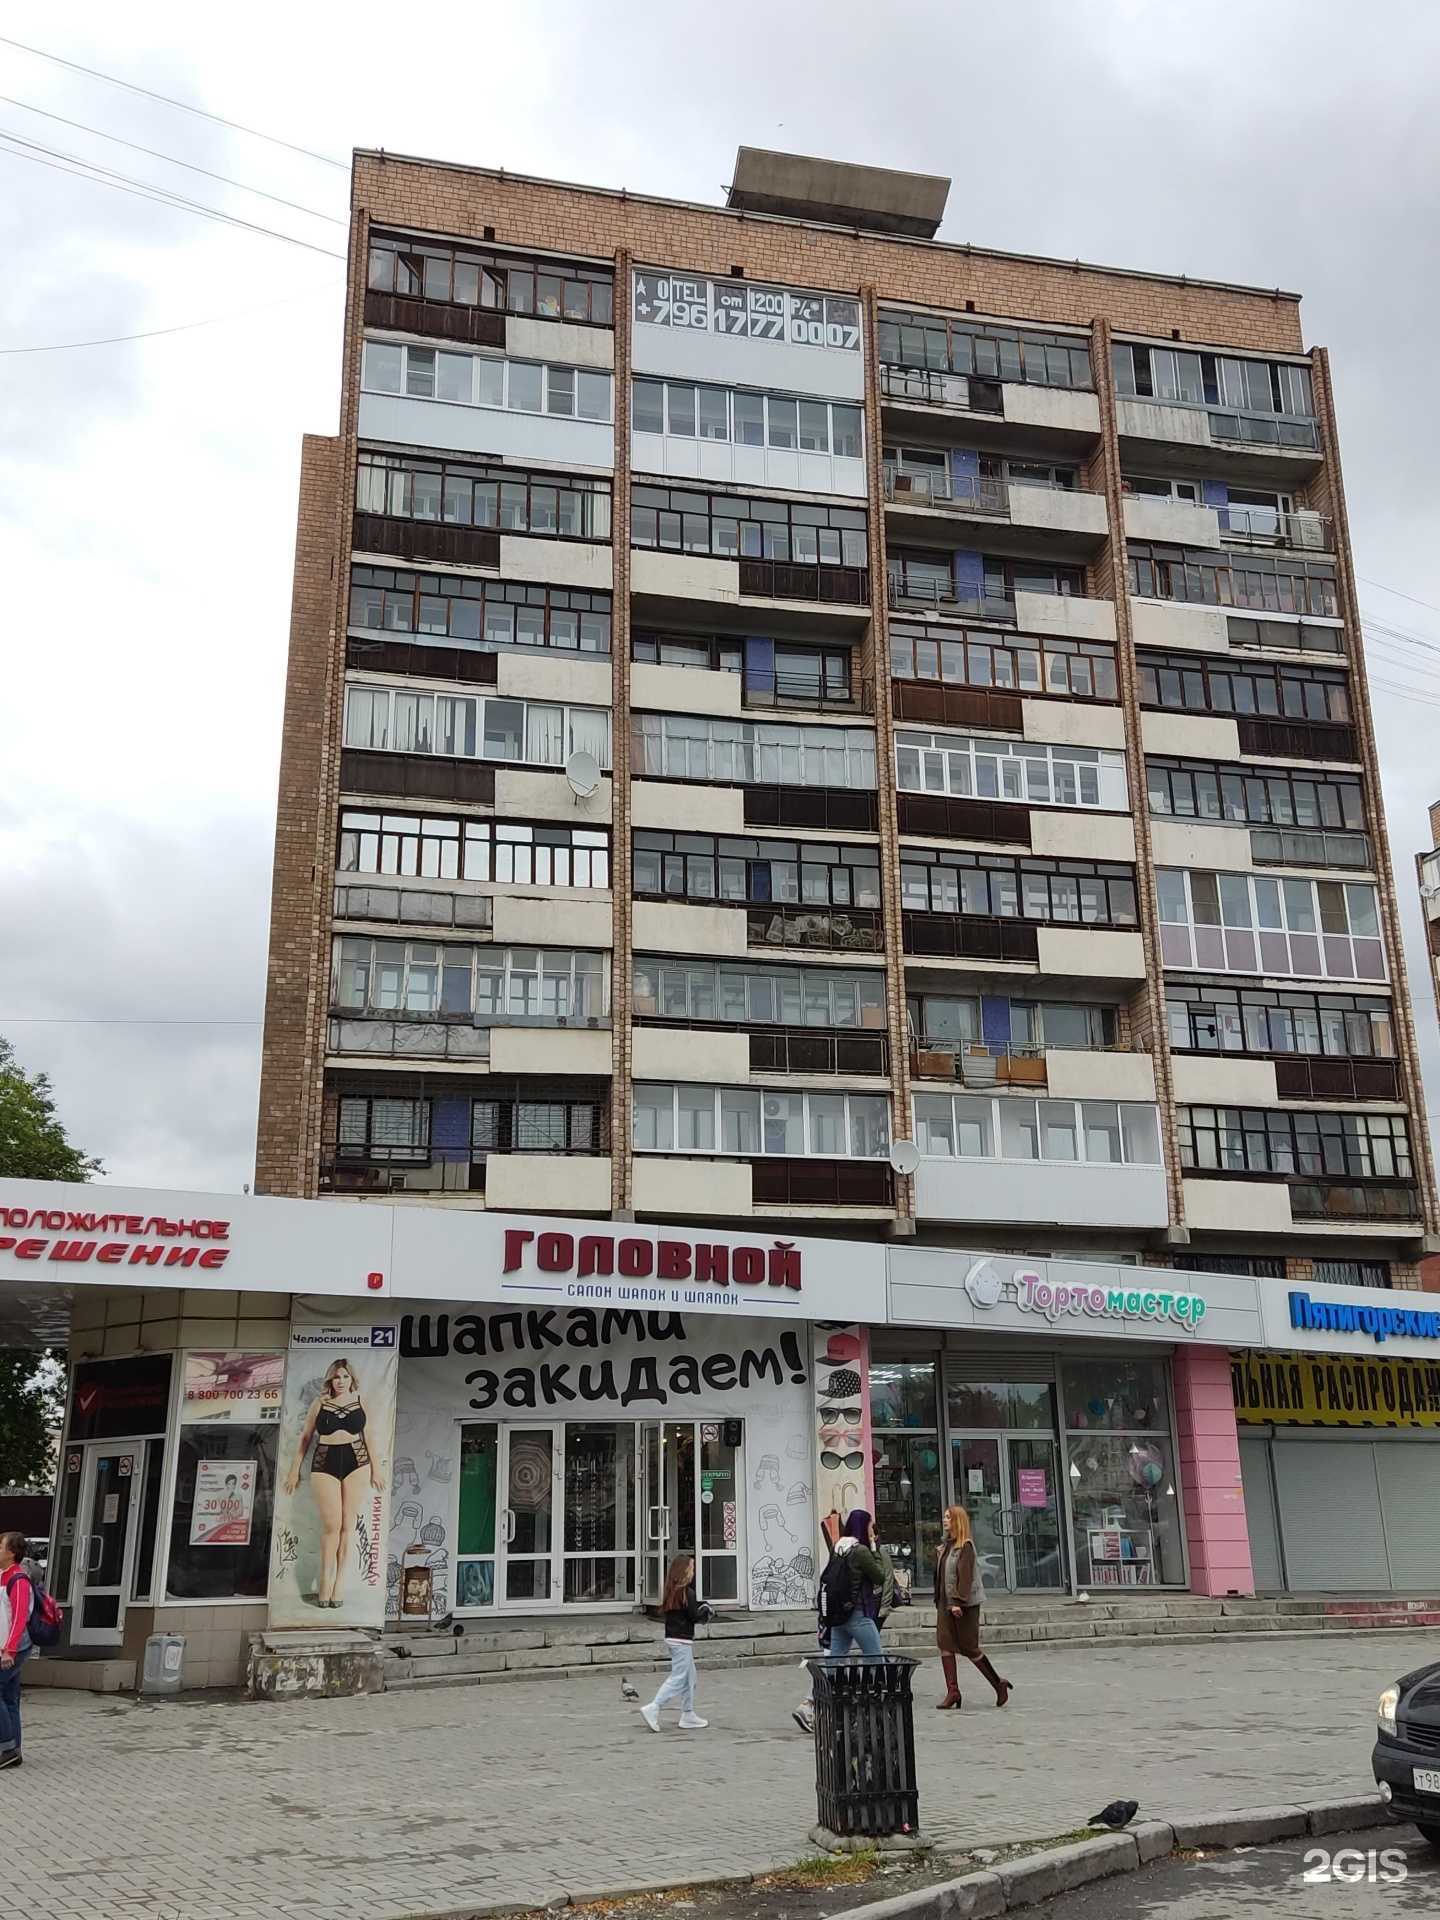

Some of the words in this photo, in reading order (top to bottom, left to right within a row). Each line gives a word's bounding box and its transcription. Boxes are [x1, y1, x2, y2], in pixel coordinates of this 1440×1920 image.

[750, 291, 784, 314] 1200
[503, 1229, 802, 1291] ГОЛОВНОЙ
[567, 1284, 612, 1298] САЛОН
[618, 1287, 666, 1301] ШАПОК
[671, 1290, 679, 1302] И
[684, 1291, 739, 1305] ШЛЯПОК
[1020, 1273, 1208, 1325] Тортомастер
[293, 1334, 369, 1344] Челюскинцев
[373, 1330, 393, 1344] 21
[400, 1307, 686, 1358] шапками
[464, 1331, 807, 1409] закидаем!
